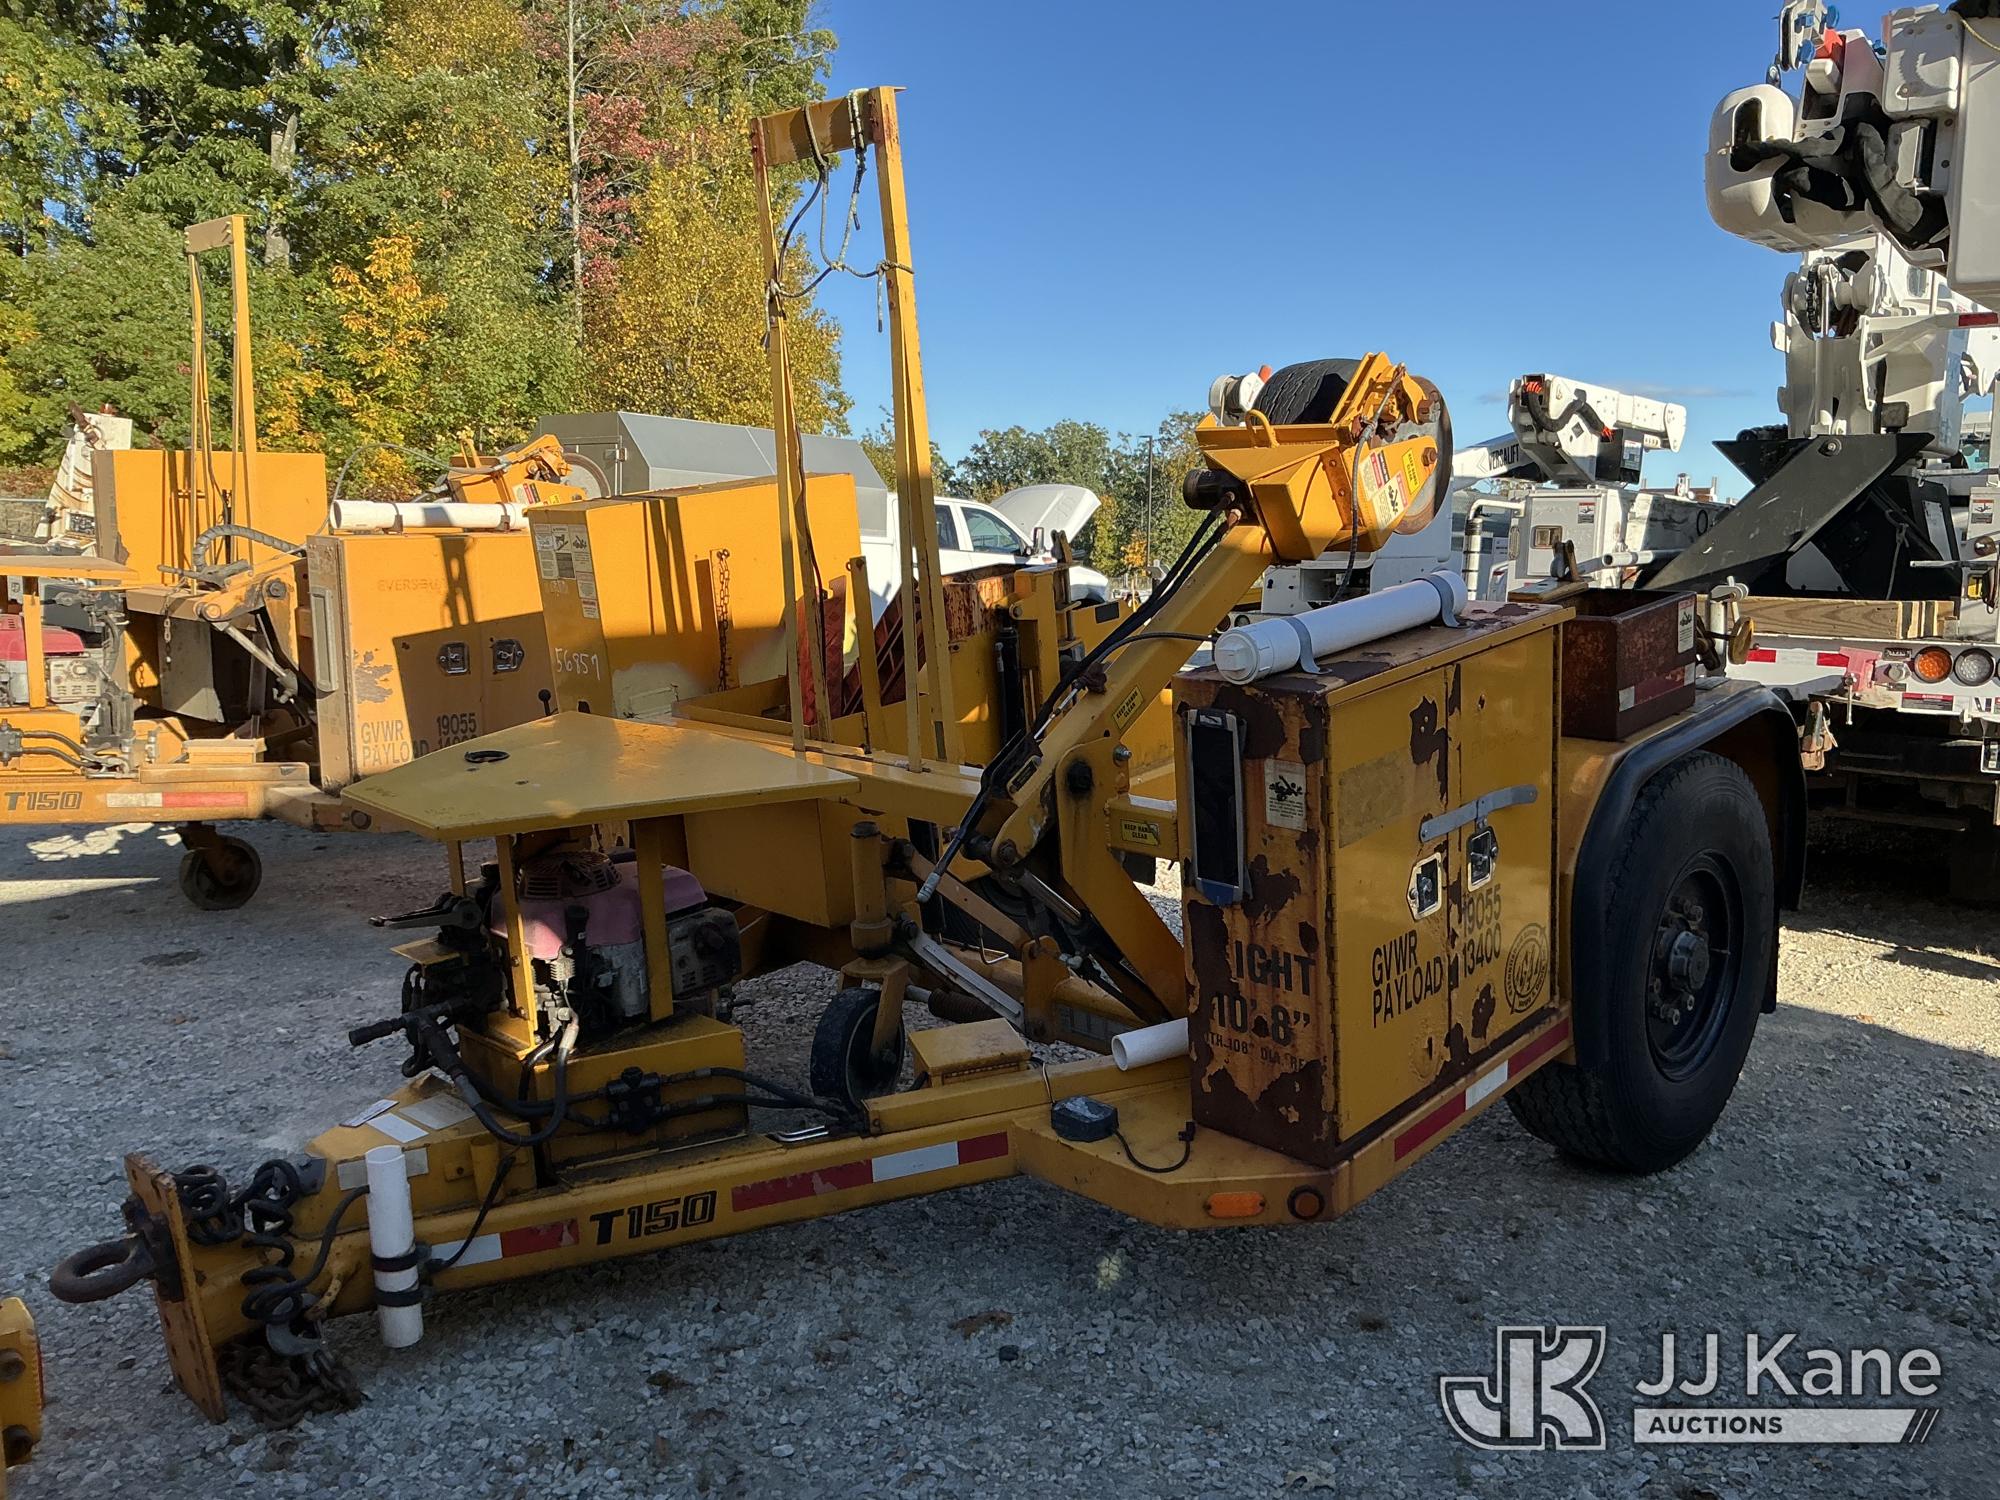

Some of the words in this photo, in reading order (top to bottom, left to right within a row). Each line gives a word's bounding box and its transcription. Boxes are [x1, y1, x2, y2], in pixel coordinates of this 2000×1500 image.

[1489, 443, 1519, 471] VERSALIFT
[361, 719, 405, 744] GVWR
[436, 712, 477, 737] 19055
[4, 791, 83, 811] T150
[1132, 831, 1148, 840] CLEAR
[1372, 929, 1418, 988] GVWR
[1462, 883, 1502, 938] 19055
[1373, 956, 1444, 1029] PAYLOAD
[1463, 922, 1502, 978] 13400
[589, 1190, 718, 1245] T150
